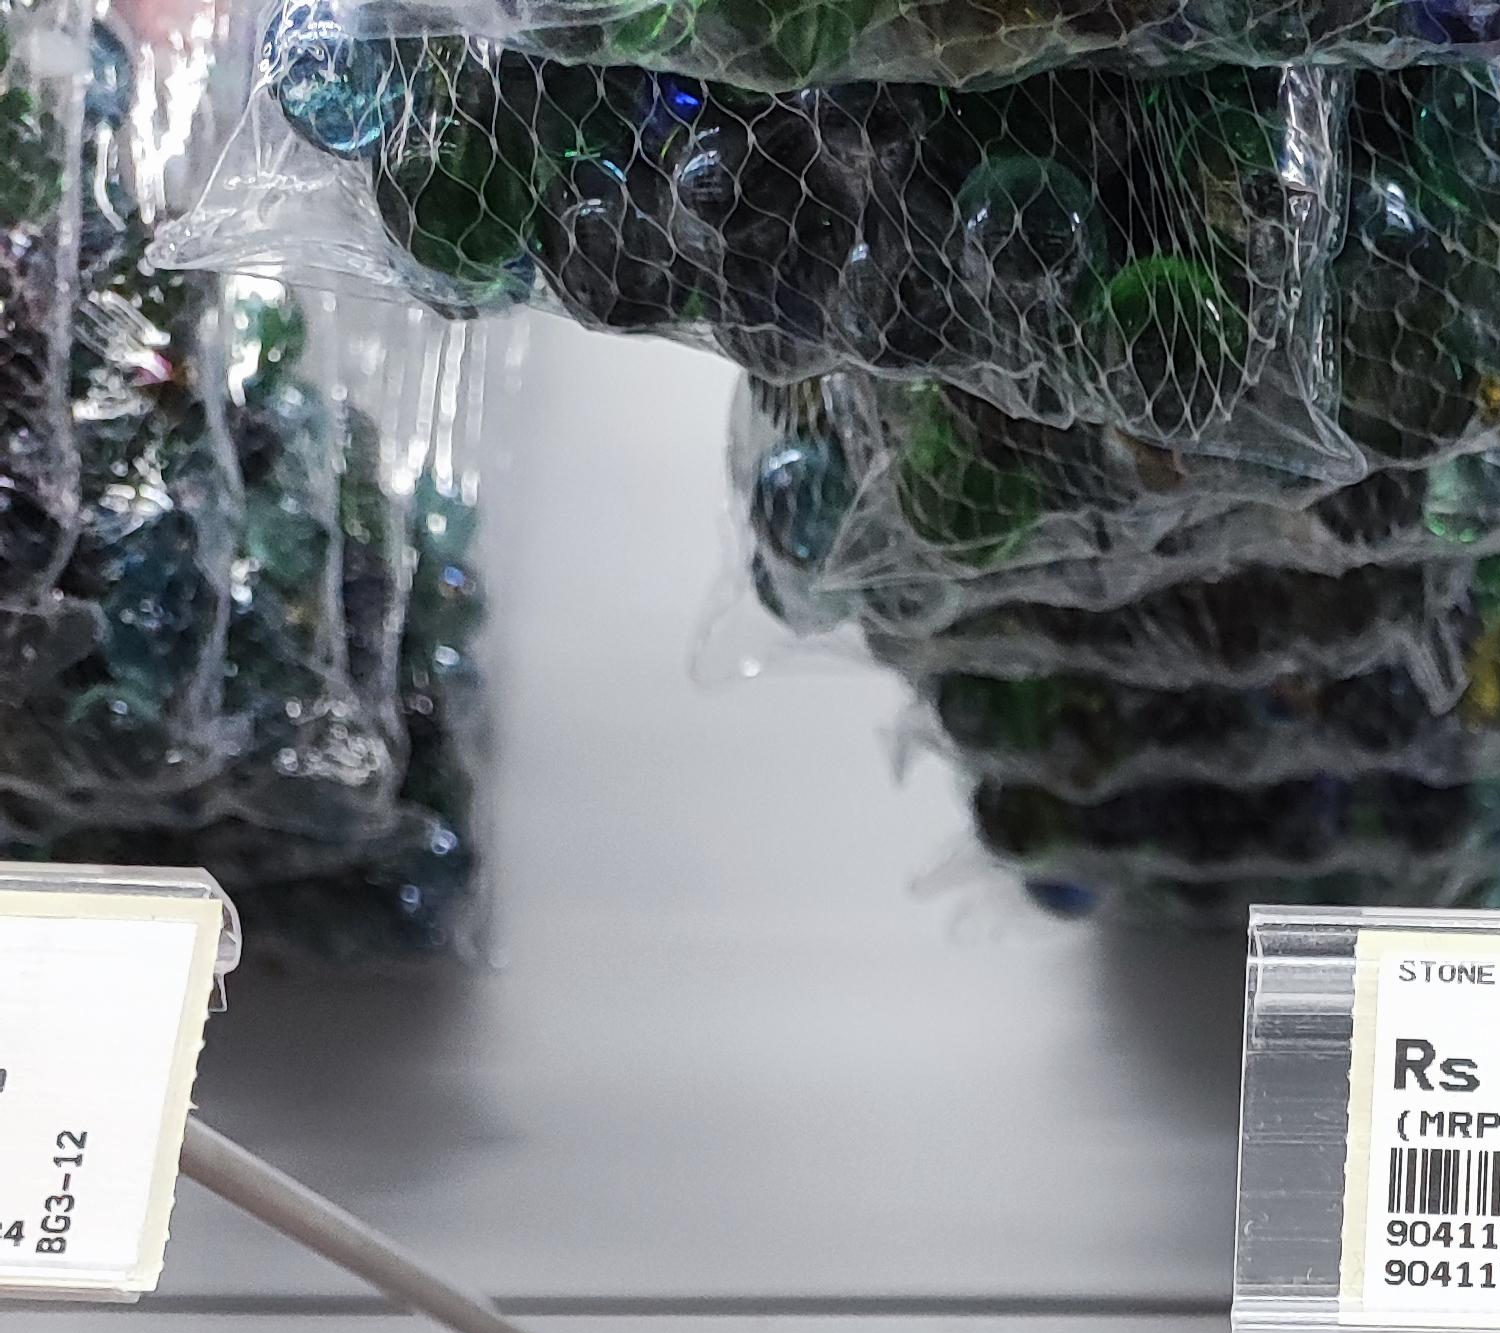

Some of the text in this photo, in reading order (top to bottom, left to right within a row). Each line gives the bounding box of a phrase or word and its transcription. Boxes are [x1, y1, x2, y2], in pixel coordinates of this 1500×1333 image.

[1398, 960, 1496, 985] STONE
[1393, 1038, 1481, 1093] Rs
[35, 1130, 88, 1254] BG3-12
[0, 1220, 24, 1247] 4
